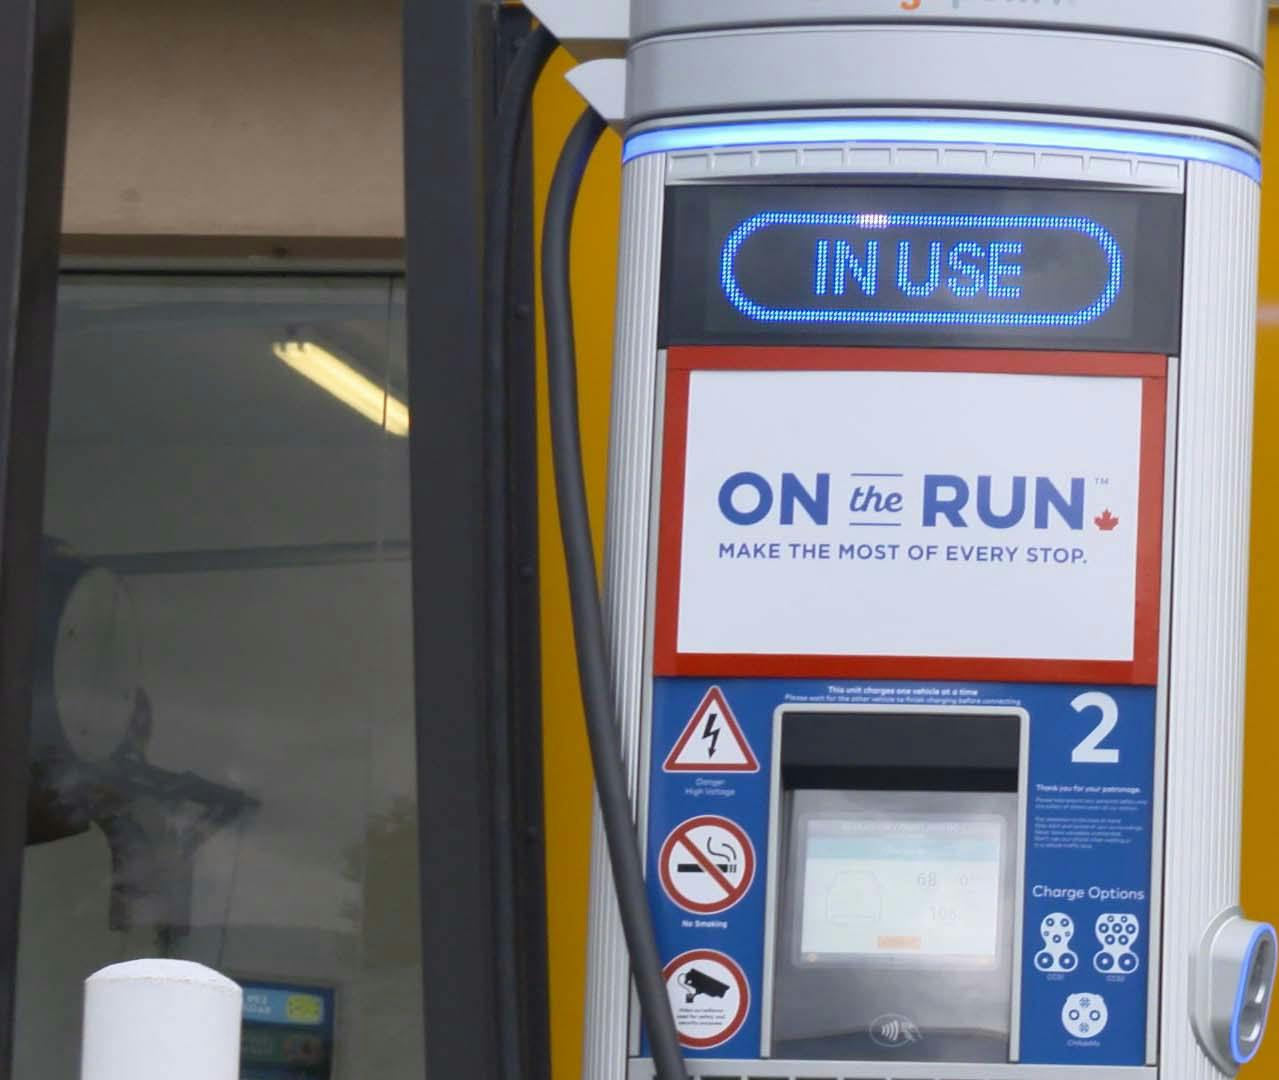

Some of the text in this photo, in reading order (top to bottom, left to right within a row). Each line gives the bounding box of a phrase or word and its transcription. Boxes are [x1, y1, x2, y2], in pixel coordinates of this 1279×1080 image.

[814, 238, 1025, 300] IN USE
[718, 471, 830, 526] ON
[849, 485, 904, 513] the
[922, 474, 1085, 531] RUN
[718, 543, 1088, 564] MAKE THE MOST OF EVERY STOP.
[828, 685, 845, 694] This
[846, 687, 863, 695] unit
[864, 686, 895, 697] charges
[896, 688, 912, 696] one
[913, 687, 940, 696] vehicle
[959, 688, 979, 697] time
[1070, 691, 1120, 763] 2
[1036, 784, 1058, 793] Thank
[1058, 786, 1072, 794] you
[1085, 786, 1101, 794] your
[1032, 885, 1145, 901] Charge Options
[681, 919, 728, 929] No Smoking
